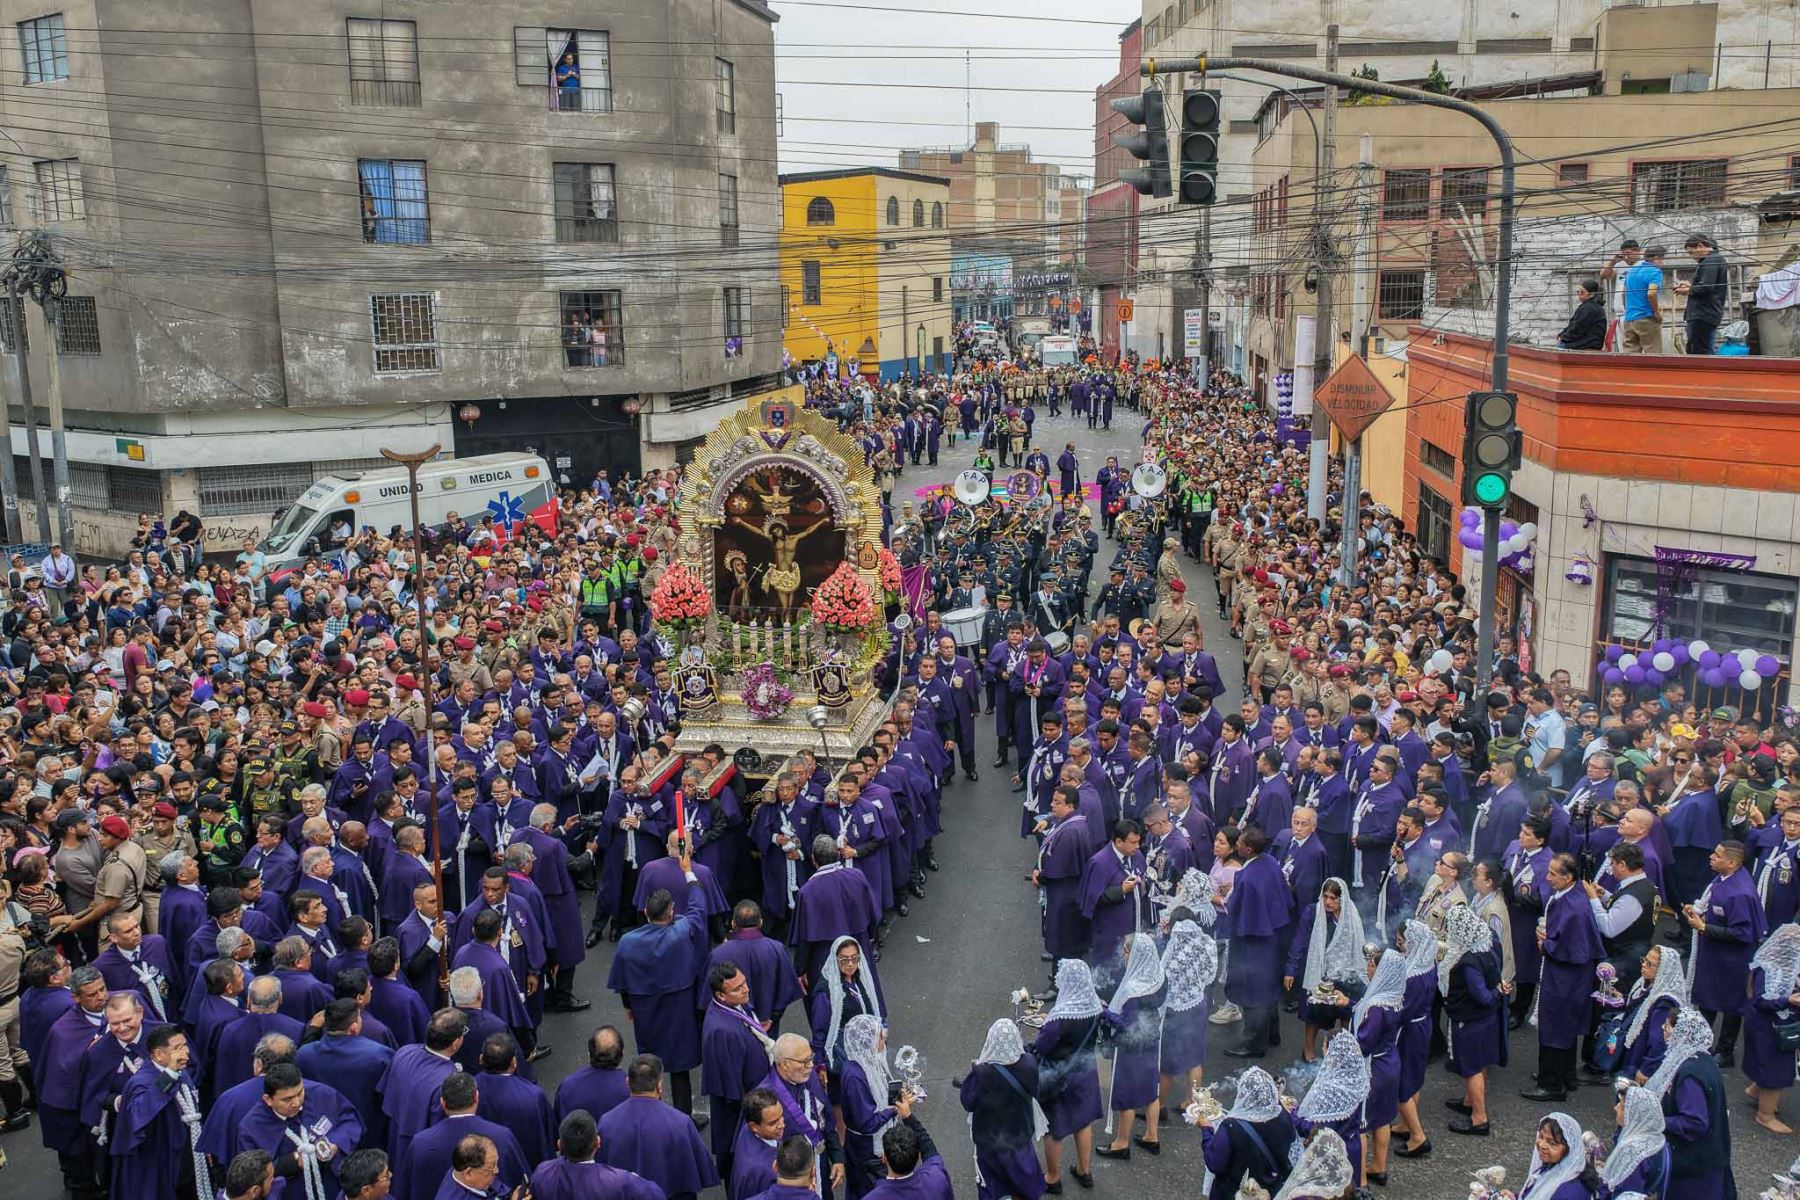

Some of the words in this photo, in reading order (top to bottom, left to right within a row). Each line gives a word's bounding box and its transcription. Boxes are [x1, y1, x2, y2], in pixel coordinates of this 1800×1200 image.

[1330, 383, 1377, 394] DISMINUIR
[1327, 398, 1378, 409] VELOCIDAD
[1139, 465, 1164, 476] FAP
[469, 471, 512, 485] MEDICA
[963, 471, 986, 484] FAP
